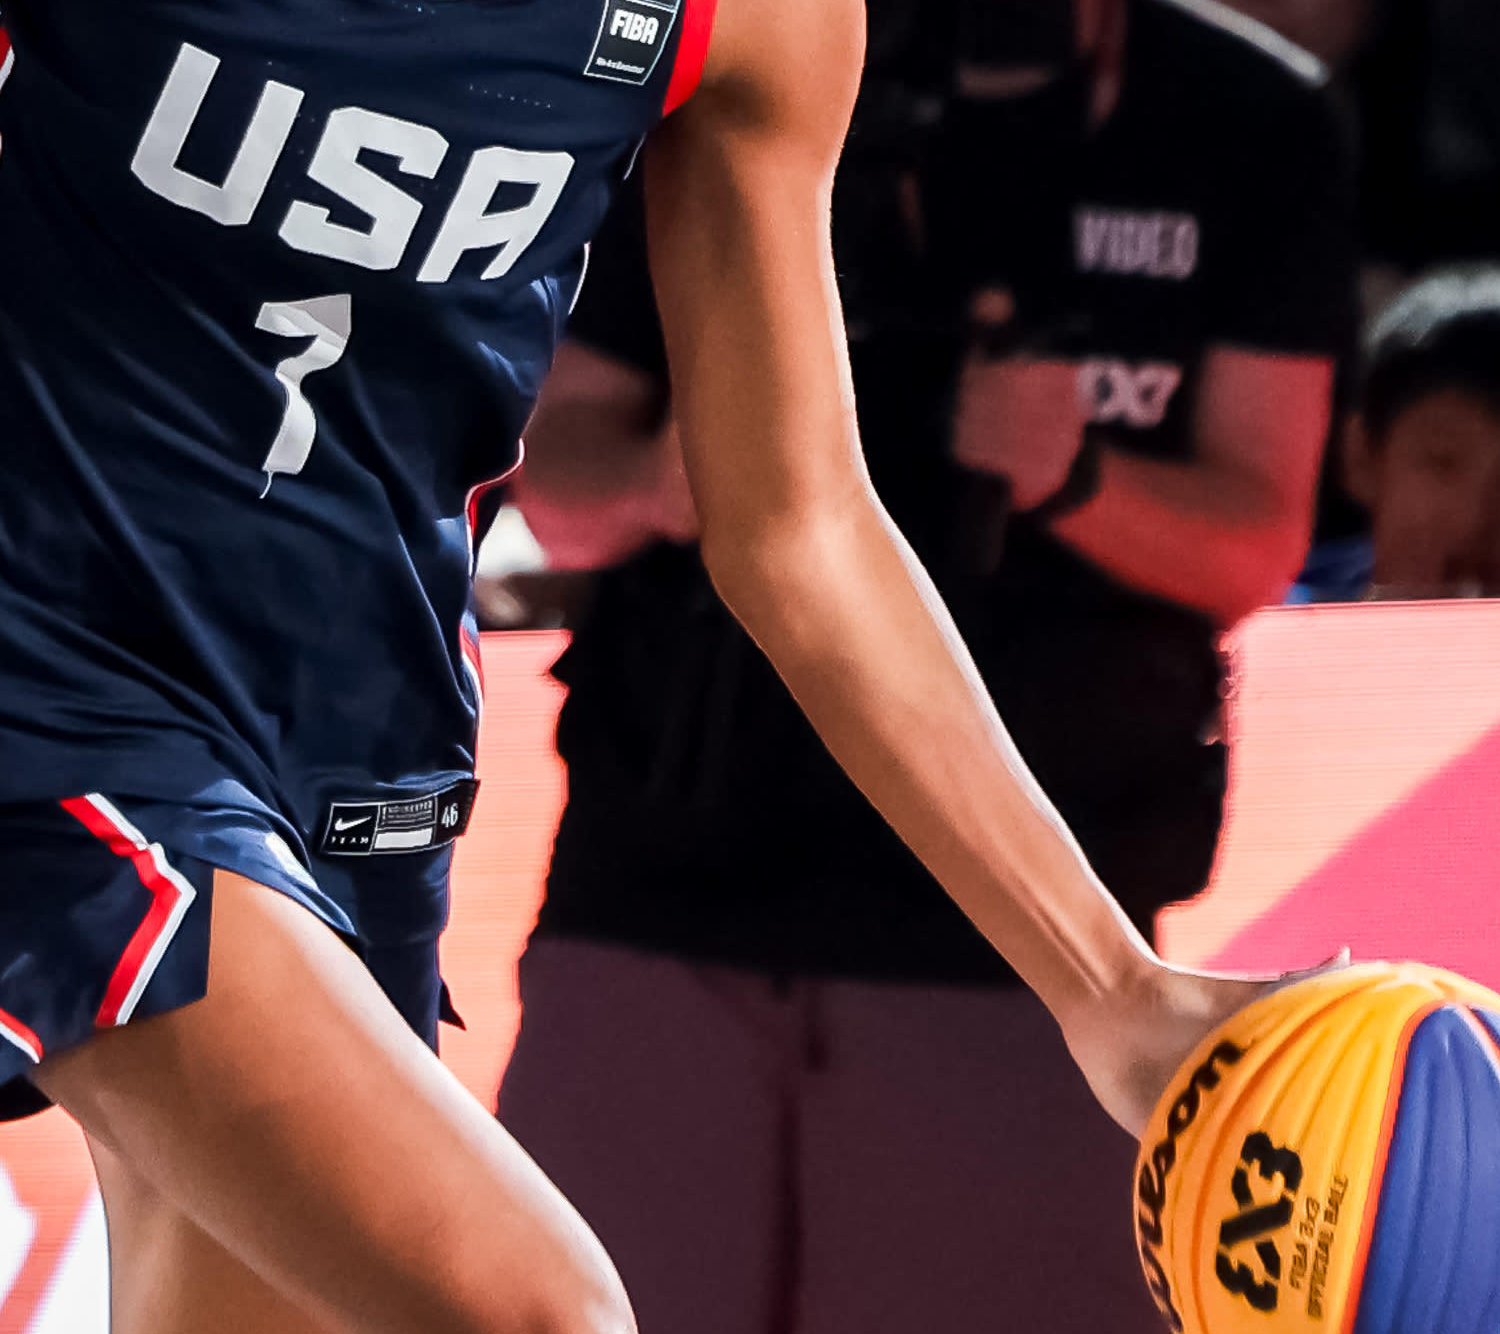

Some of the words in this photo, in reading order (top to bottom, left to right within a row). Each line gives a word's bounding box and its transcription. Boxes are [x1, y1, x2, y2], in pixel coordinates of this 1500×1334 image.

[609, 9, 659, 45] FIBA
[130, 42, 575, 283] USA
[440, 802, 459, 828] 46
